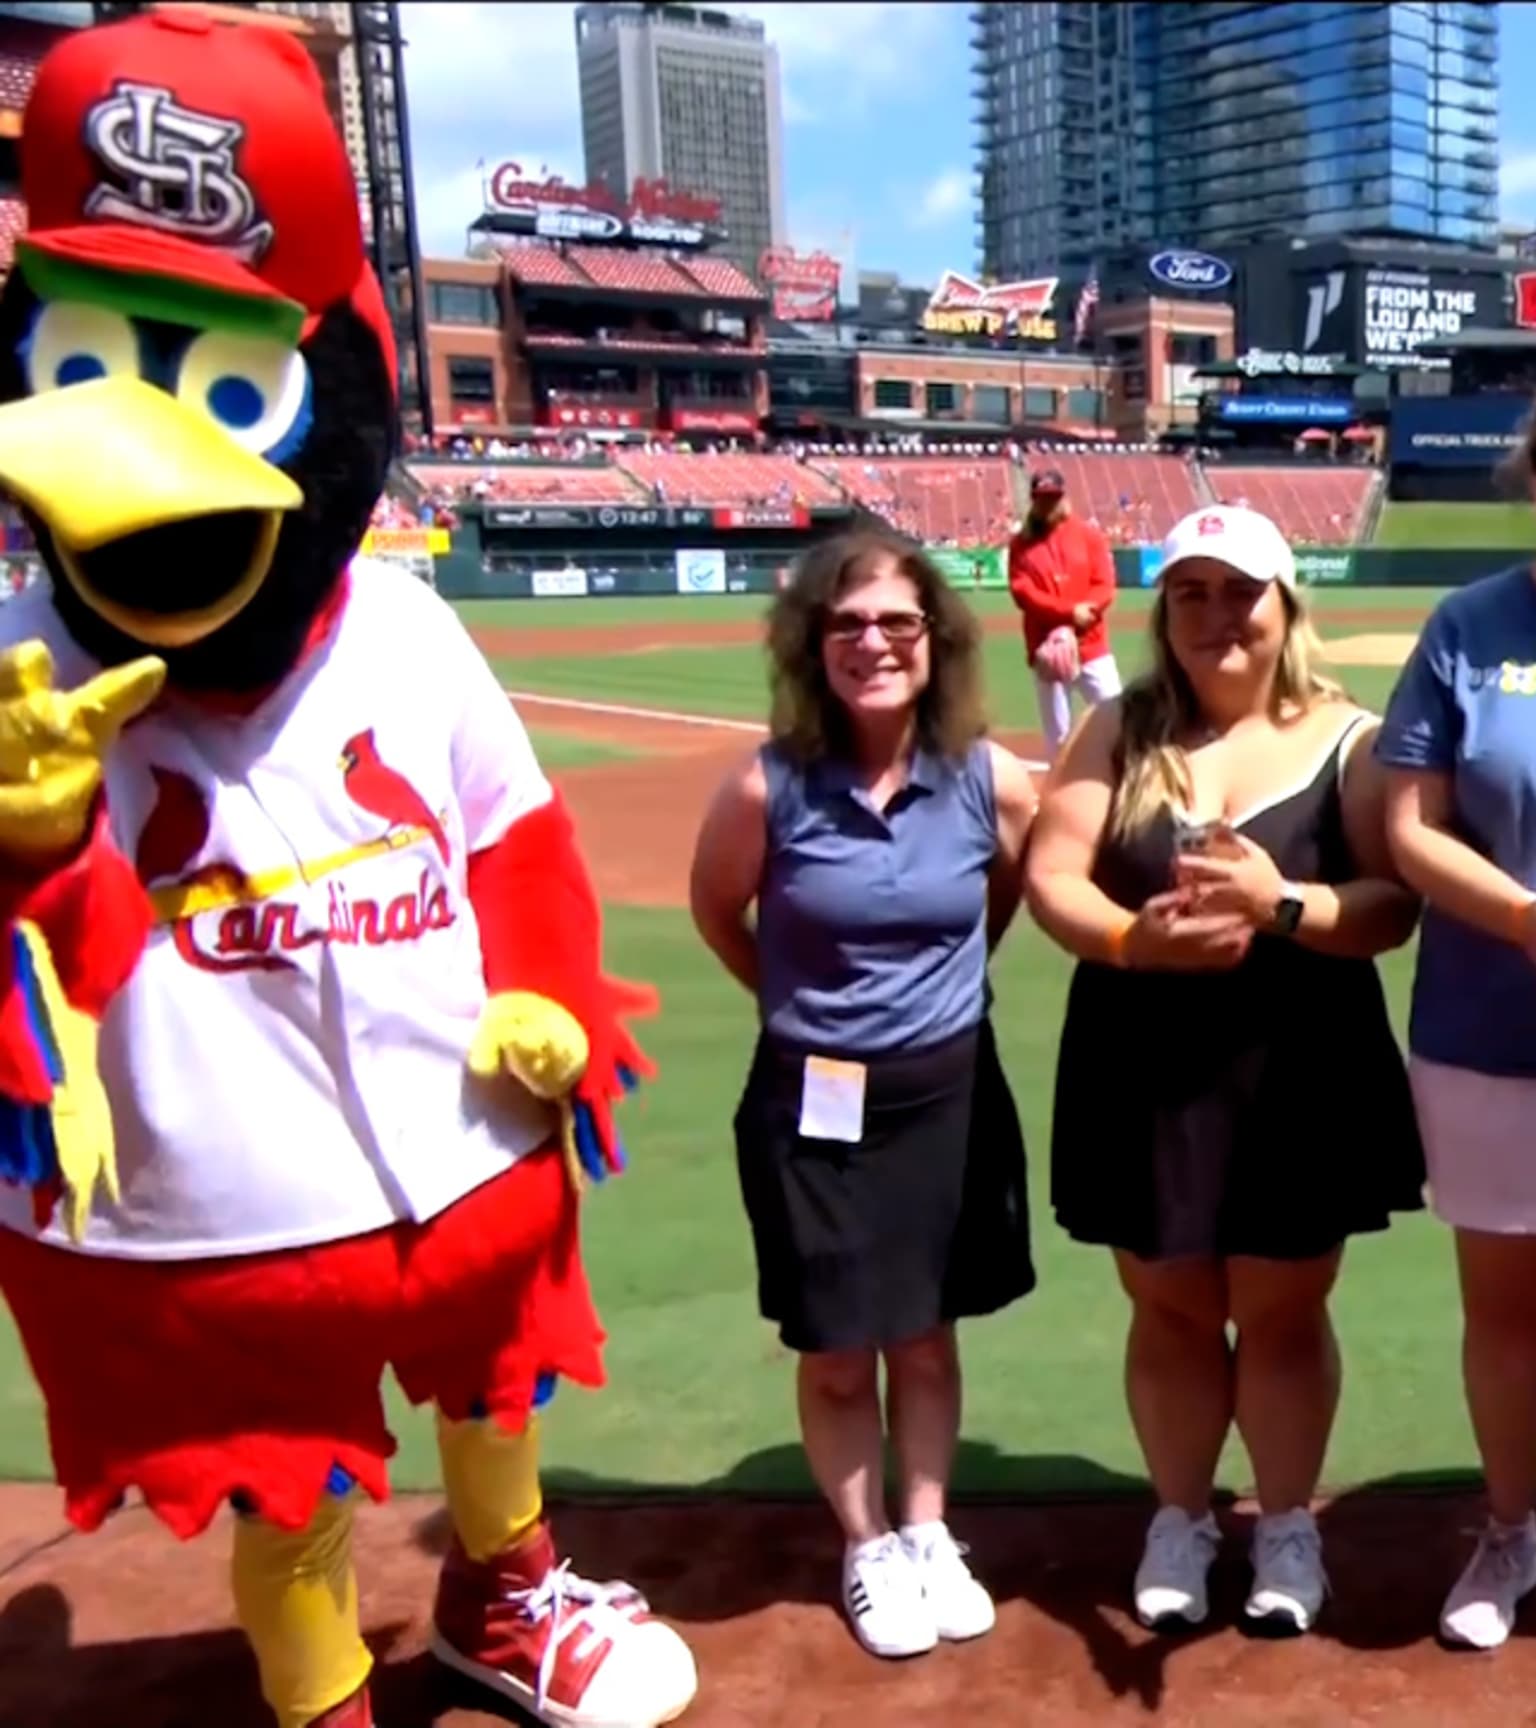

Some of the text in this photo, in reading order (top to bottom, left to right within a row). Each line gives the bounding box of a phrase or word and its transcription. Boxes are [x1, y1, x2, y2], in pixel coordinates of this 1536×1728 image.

[1167, 255, 1218, 283] Ford
[1365, 286, 1476, 314] FROM THE
[1365, 308, 1461, 334] LOU AND
[1410, 432, 1462, 449] OFFICIAL
[172, 866, 456, 974] Cardinals
